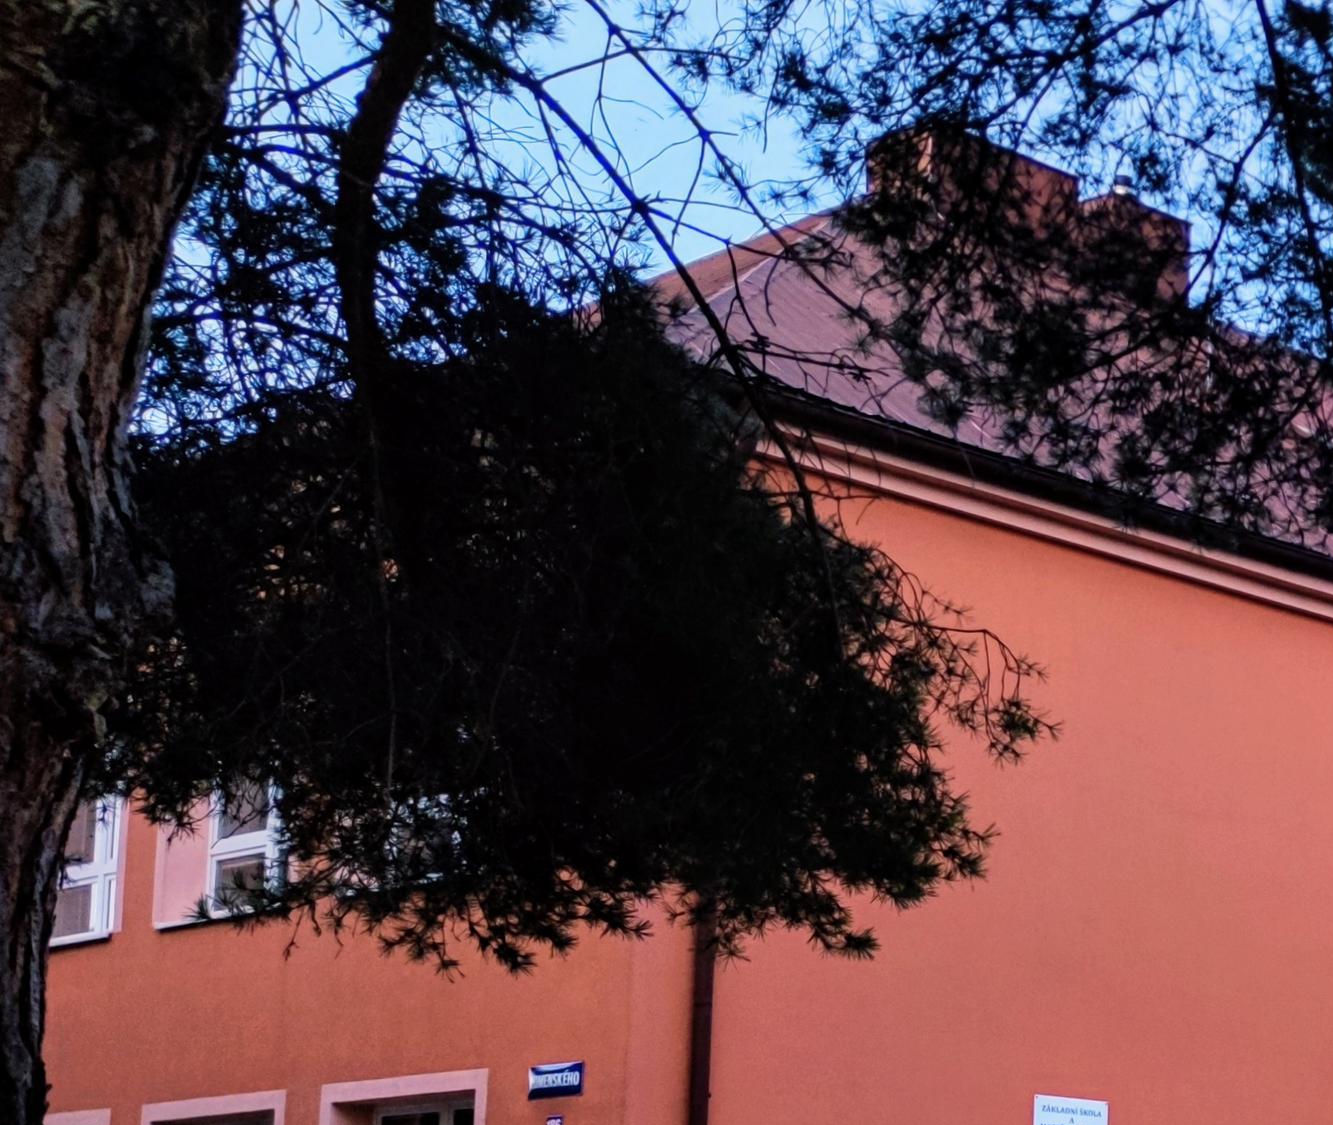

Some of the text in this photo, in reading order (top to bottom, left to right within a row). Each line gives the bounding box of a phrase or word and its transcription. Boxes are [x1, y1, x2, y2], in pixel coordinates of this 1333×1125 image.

[532, 1070, 580, 1088] ENSKÉHO
[1041, 1104, 1102, 1117] ZÁKLADNÍ ŠKOLA
